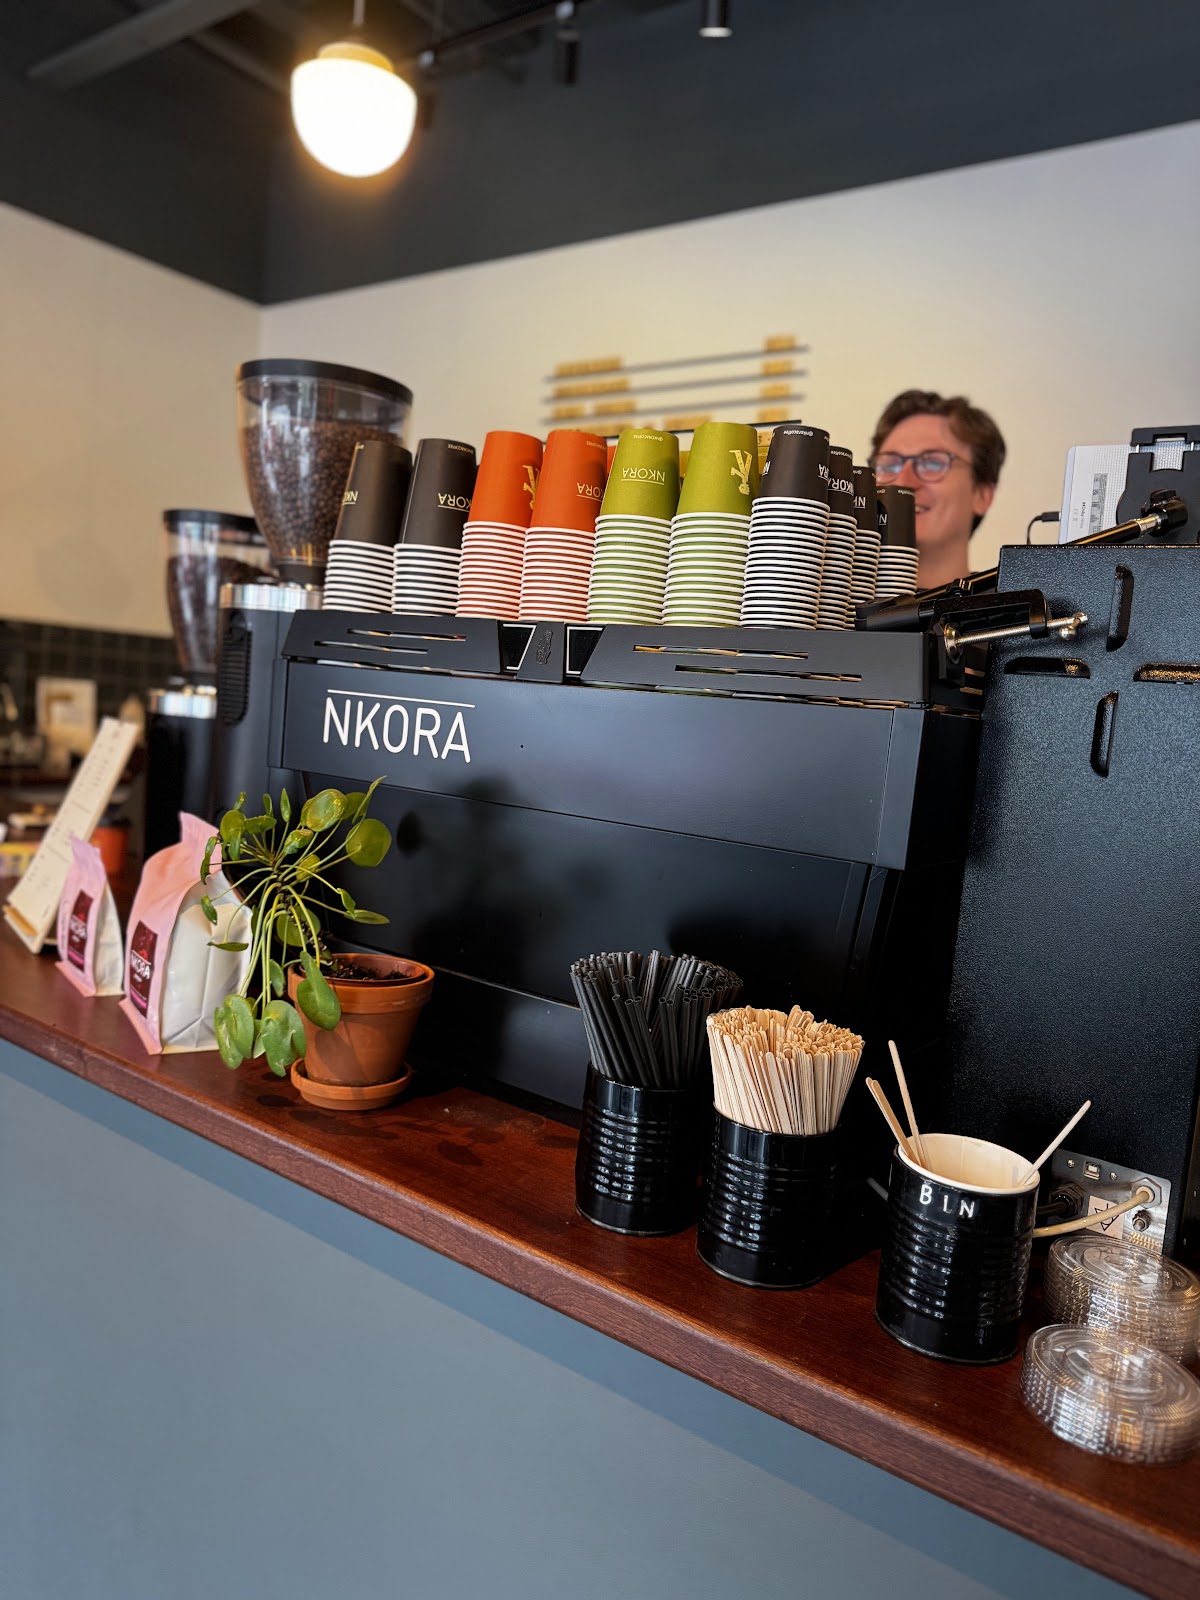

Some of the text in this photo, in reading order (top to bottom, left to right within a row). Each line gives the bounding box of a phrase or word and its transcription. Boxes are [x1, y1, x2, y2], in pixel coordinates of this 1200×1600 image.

[622, 467, 666, 483] NKORA
[577, 483, 604, 499] ORA
[438, 492, 472, 510] KORA
[322, 697, 471, 764] NKORA
[919, 1183, 975, 1218] BIN
